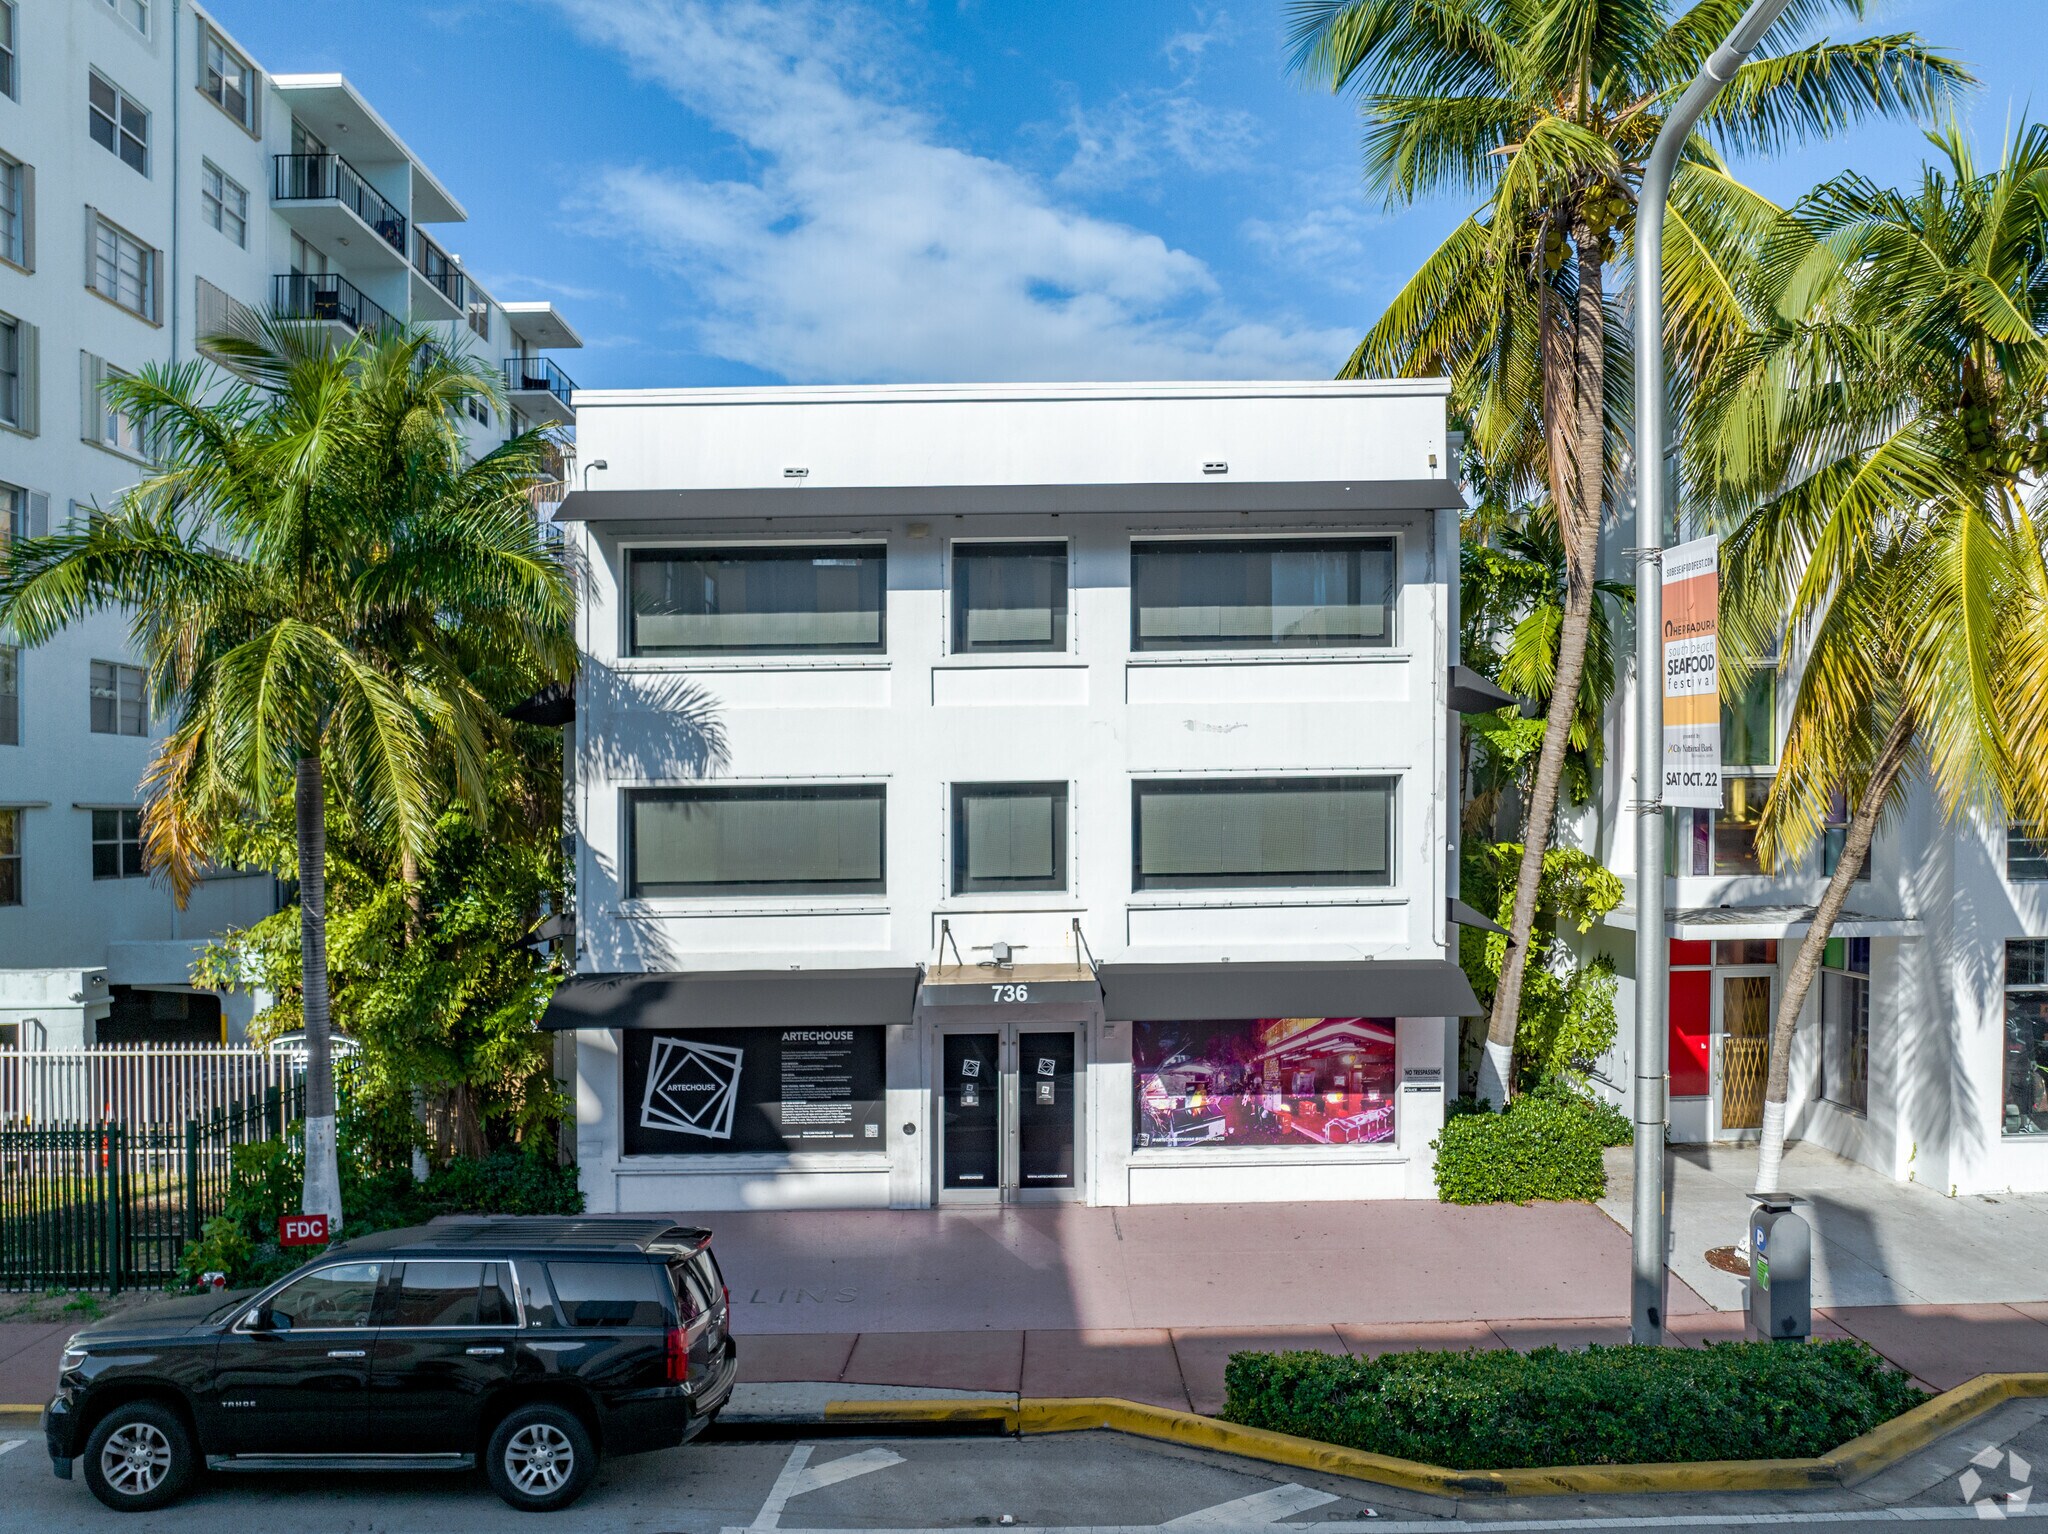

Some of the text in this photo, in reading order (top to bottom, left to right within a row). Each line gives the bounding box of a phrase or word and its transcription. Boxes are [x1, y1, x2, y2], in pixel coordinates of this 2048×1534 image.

[1666, 557, 1714, 578] SOBESEAFOODFEST.COM
[1668, 639, 1715, 658] south beach
[1667, 653, 1715, 676] SEAFOOD
[1668, 672, 1715, 690] festival
[1673, 743, 1714, 754] City National Bank
[1666, 772, 1718, 787] SAT OCT. 22
[991, 984, 1028, 1003] 736
[781, 1030, 854, 1041] ARTECHOUSE
[1413, 1068, 1441, 1076] TRESPASSING
[667, 1083, 716, 1092] ARTECHOUSE
[286, 1220, 323, 1239] FDC
[1756, 1228, 1765, 1246] P
[221, 1400, 257, 1408] TAHOE
